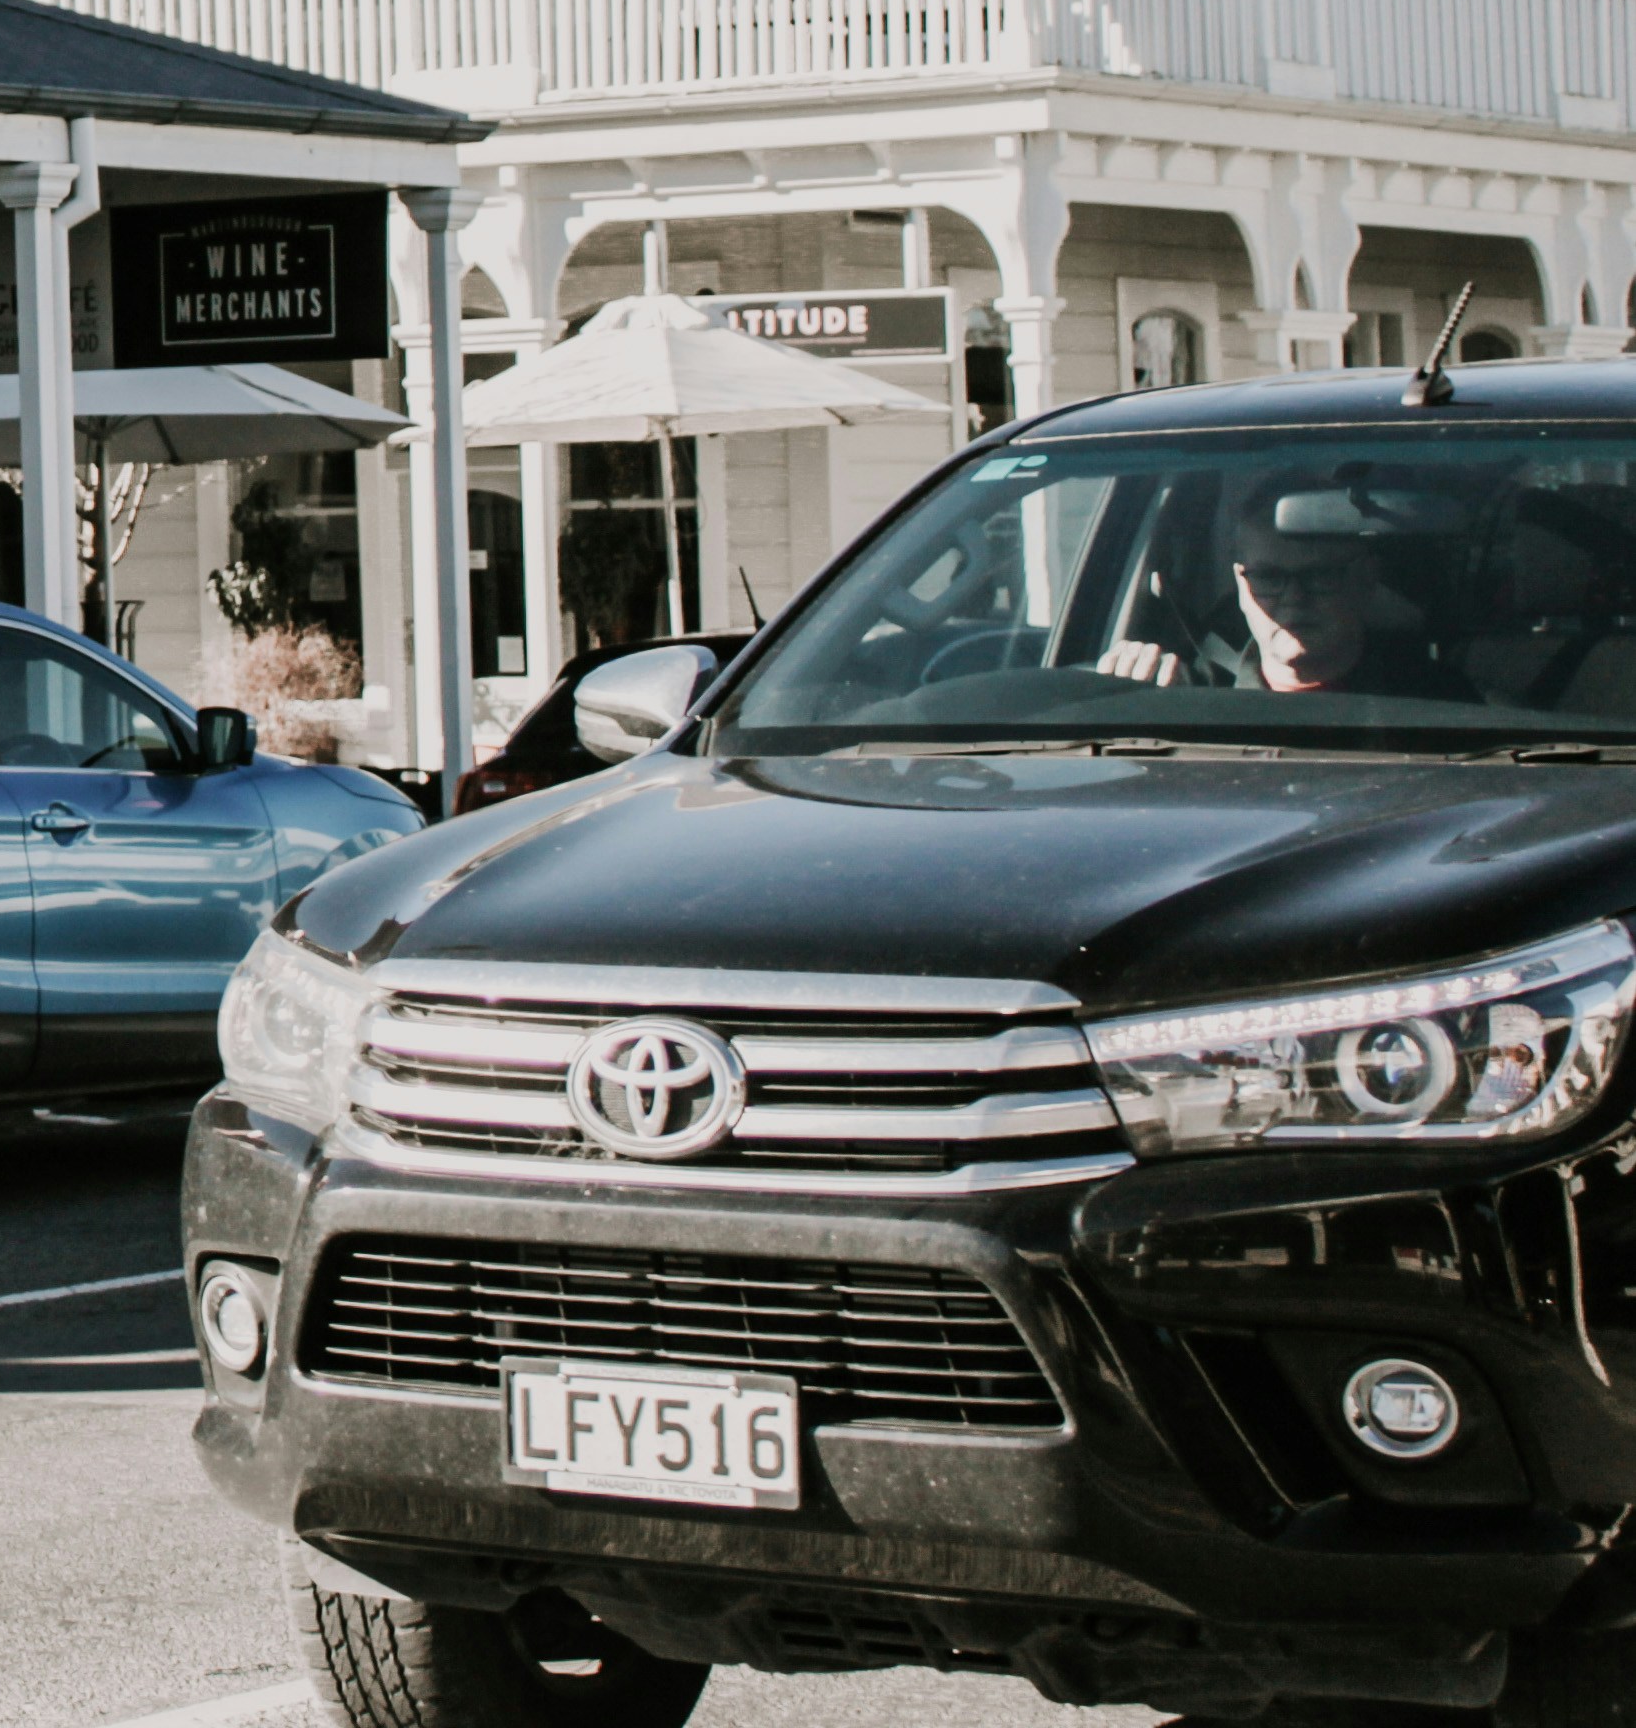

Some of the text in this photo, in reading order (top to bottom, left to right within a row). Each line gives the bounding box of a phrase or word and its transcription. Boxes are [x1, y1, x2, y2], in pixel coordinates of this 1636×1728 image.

[206, 241, 289, 279] WINE
[175, 287, 322, 324] MERCHANTS
[727, 305, 869, 337] LTITUDE
[520, 1386, 785, 1479] LFY516
[691, 1486, 738, 1501] TOYOTA
